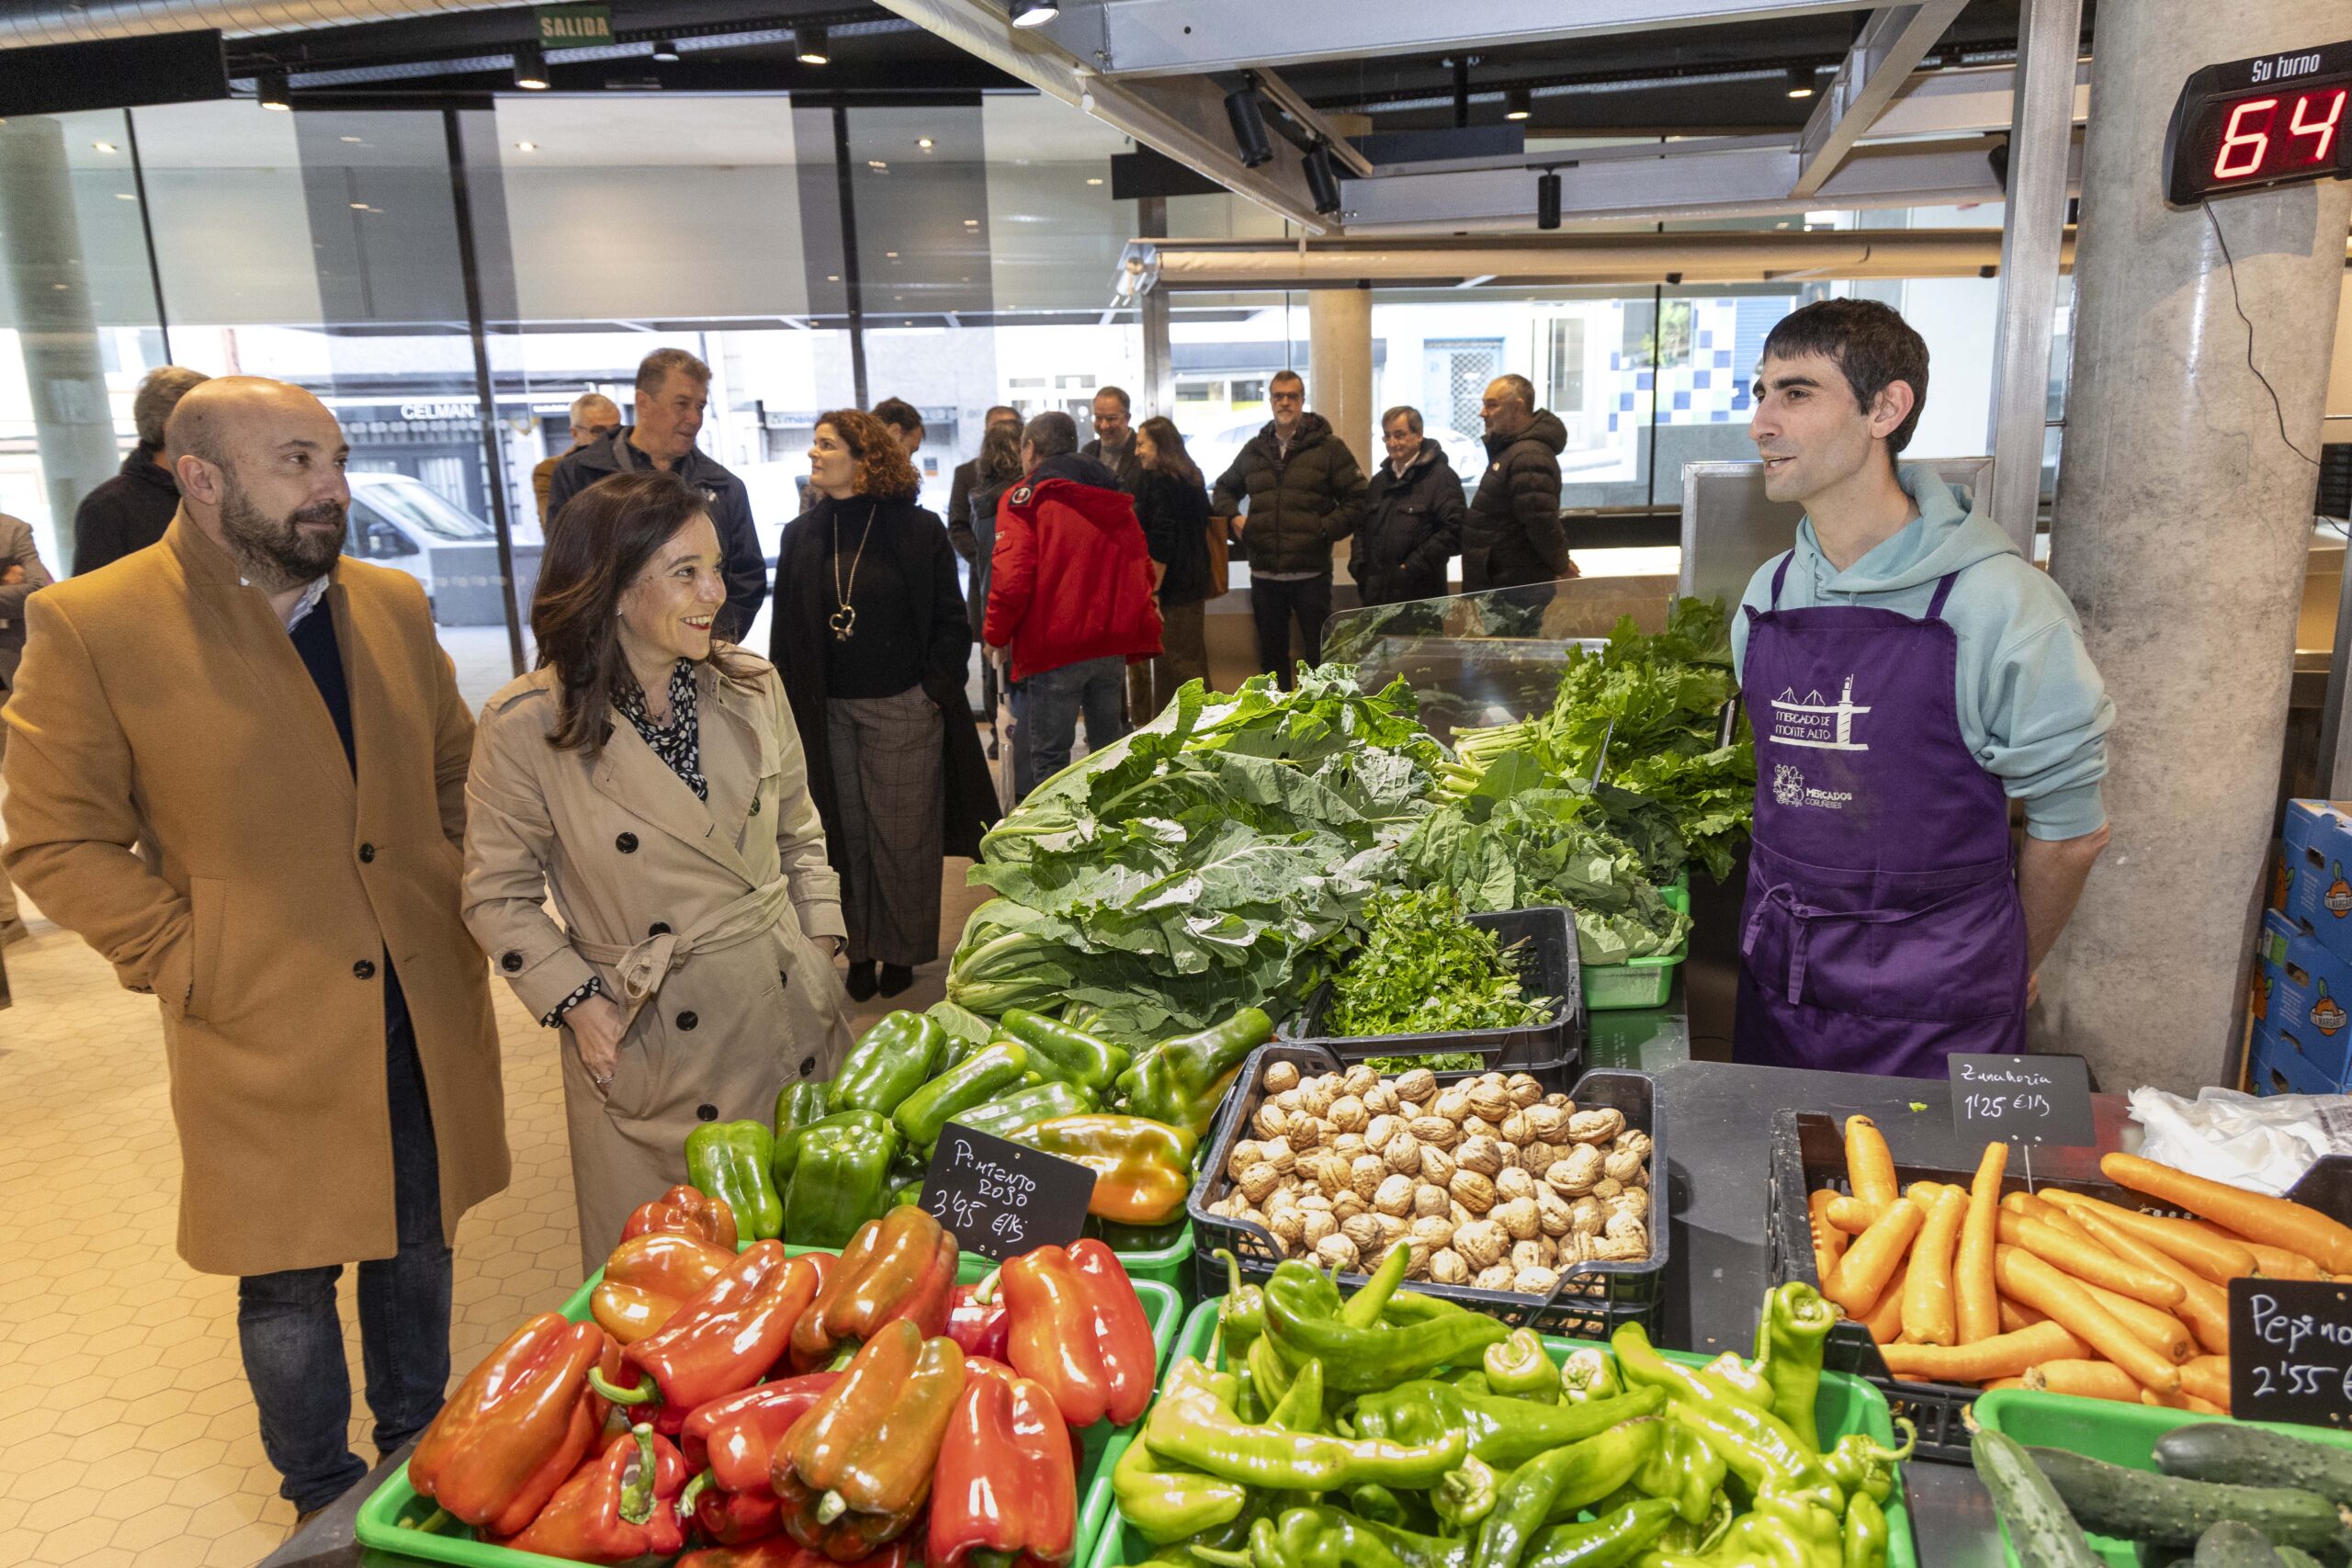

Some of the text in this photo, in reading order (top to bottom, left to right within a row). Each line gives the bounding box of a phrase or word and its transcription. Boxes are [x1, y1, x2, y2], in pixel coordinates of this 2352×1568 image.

[539, 16, 609, 37] SALIDA
[2251, 53, 2321, 83] Su turno
[2214, 90, 2346, 178] 64
[401, 403, 476, 420] CELMAN
[1775, 711, 1831, 727] MERCADO DE
[1775, 724, 1831, 740] MONTE ALTO
[1806, 787, 1852, 801] MERCADOS
[1961, 1064, 2052, 1085] Zanahoria
